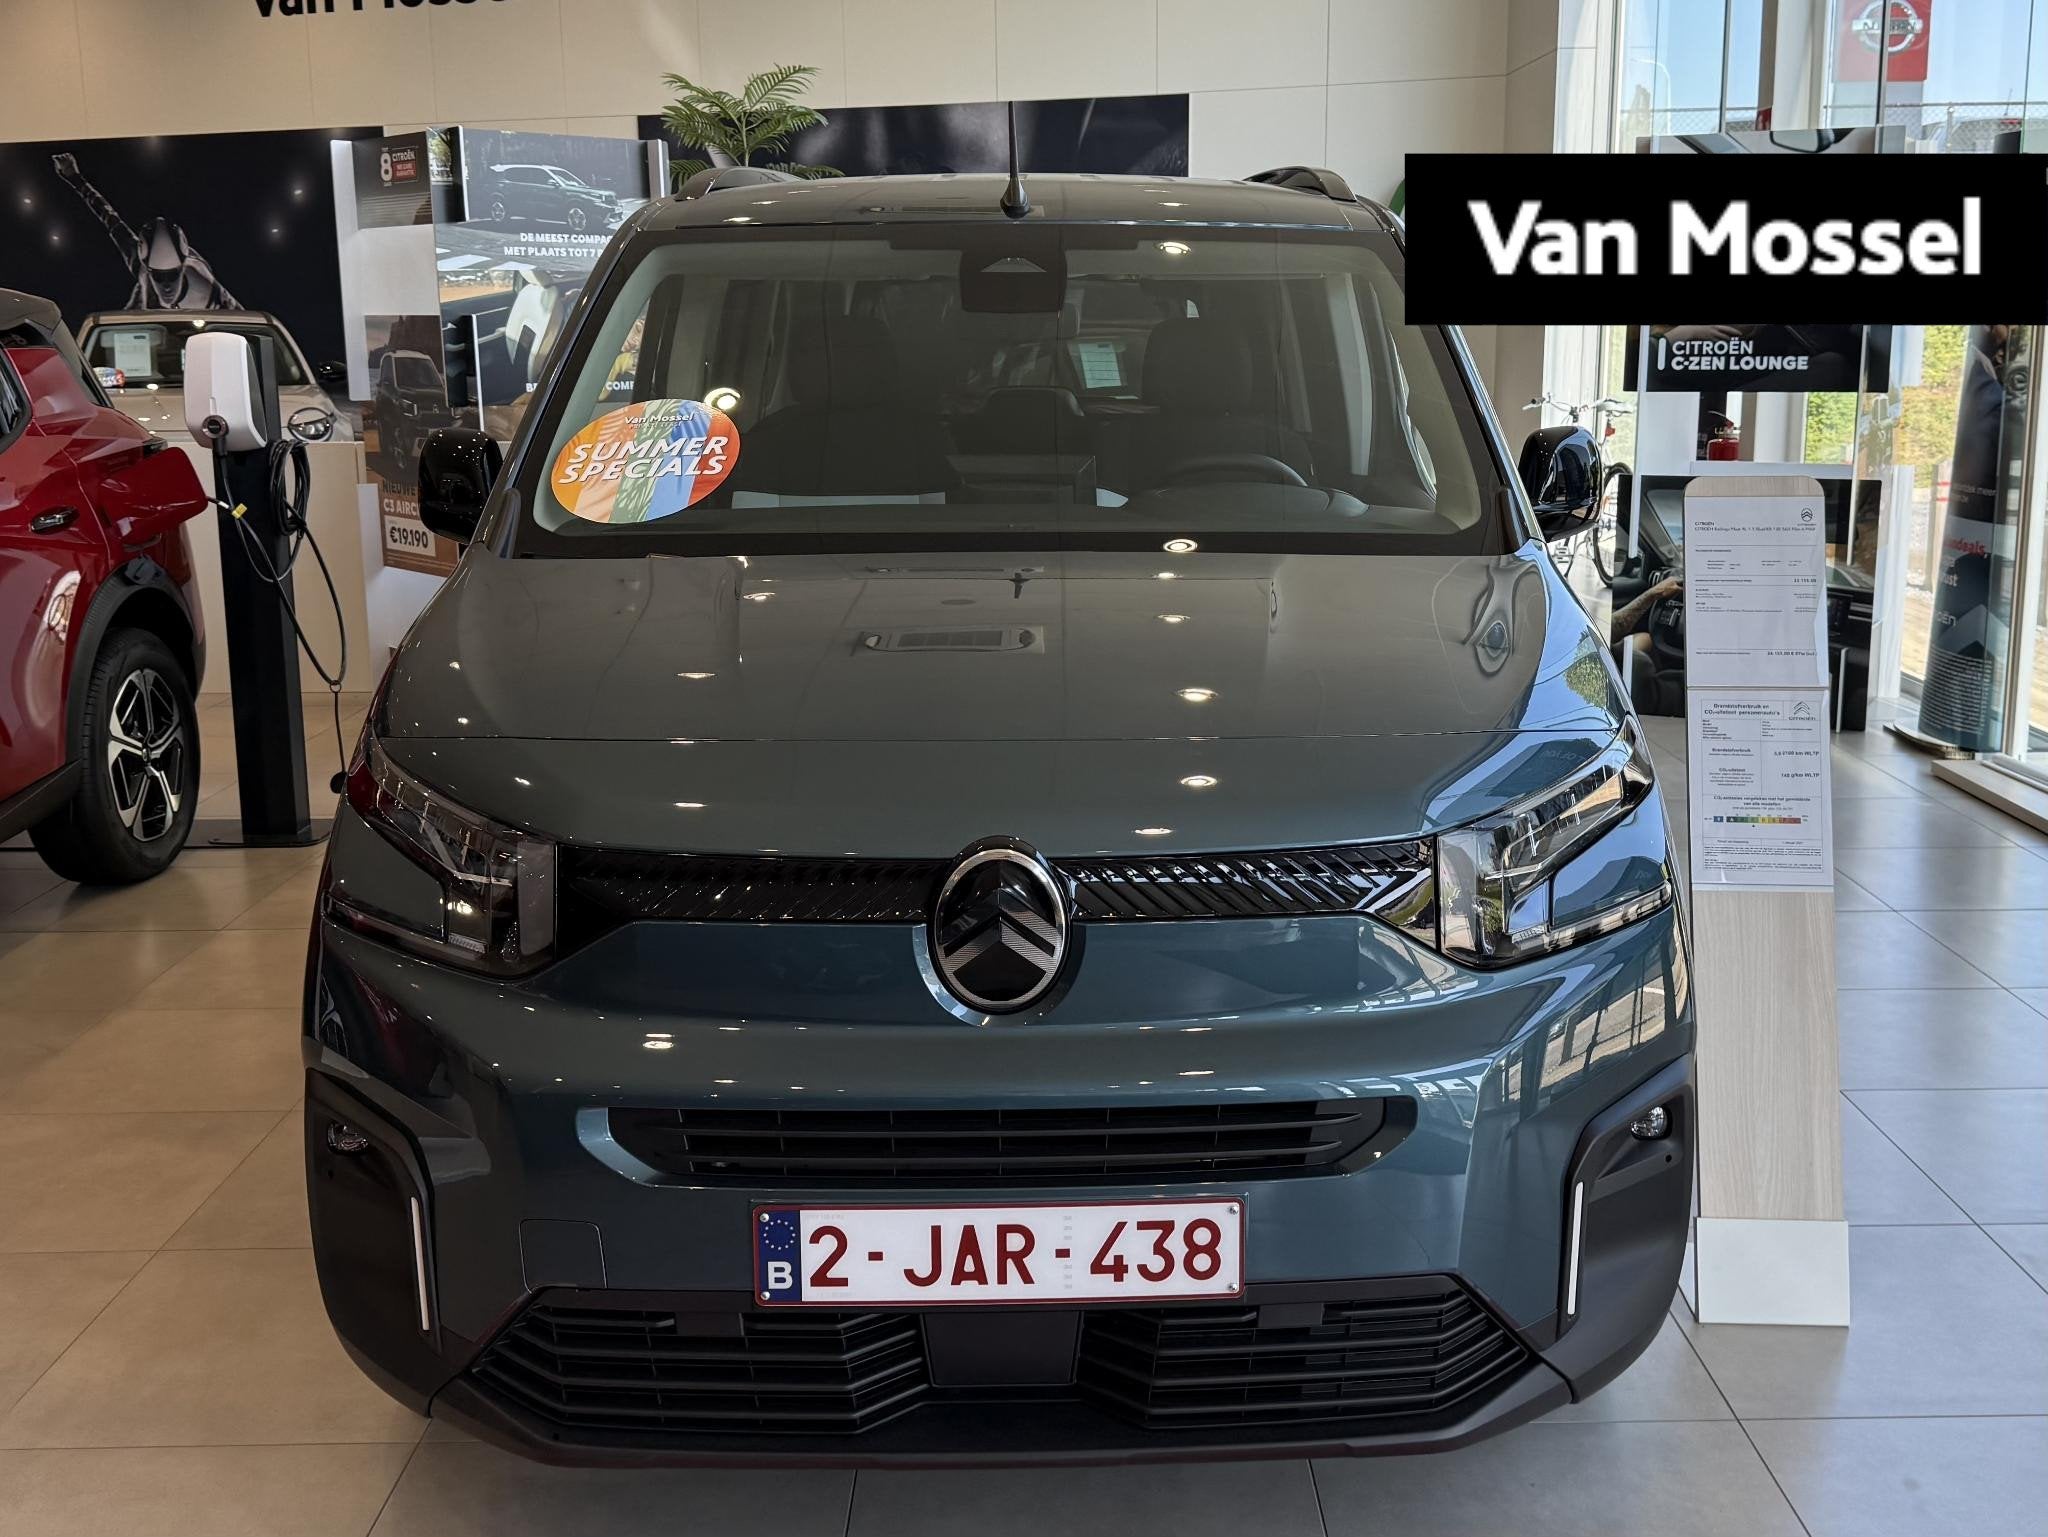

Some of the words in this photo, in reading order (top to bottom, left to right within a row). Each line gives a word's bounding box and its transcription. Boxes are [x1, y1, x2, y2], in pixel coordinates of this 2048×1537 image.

[520, 232, 534, 242] DE
[535, 233, 569, 243] MEEST
[504, 246, 526, 255] MET
[528, 247, 567, 256] PLAATS
[568, 248, 588, 257] TOT
[1672, 336, 1753, 355] CITROËN
[1729, 355, 1809, 371] LOUNGE
[568, 436, 729, 464] SUMMER
[558, 455, 728, 484] SPECIALS
[396, 502, 419, 516] AIRC
[389, 526, 429, 549] €19.190
[808, 1218, 1222, 1287] 2-JAR-438
[767, 1261, 793, 1290] B
